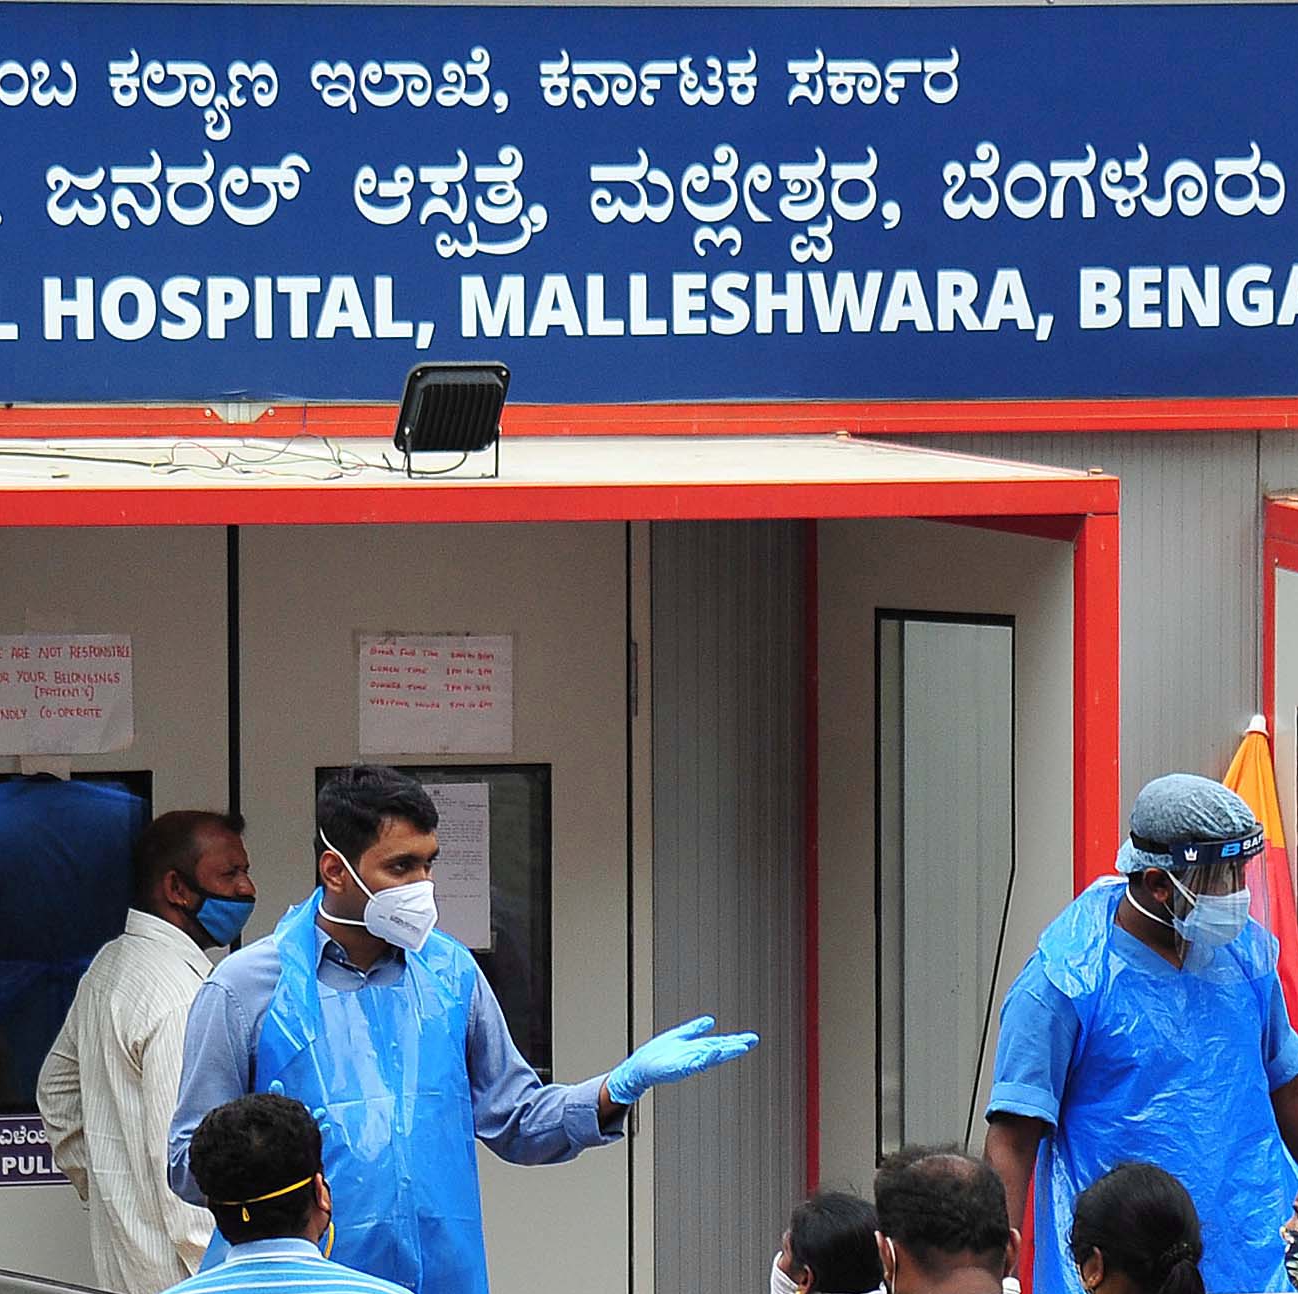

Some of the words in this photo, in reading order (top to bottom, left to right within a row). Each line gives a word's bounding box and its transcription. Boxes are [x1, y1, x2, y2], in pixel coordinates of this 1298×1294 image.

[109, 49, 279, 141] ಕಲ್ಯಾಣ
[310, 47, 509, 114] ಇಲಾಖೆ,
[539, 49, 758, 109] ಕರ್ನಾಟಕ
[787, 47, 959, 106] ಸರ್ಕಾರ
[46, 149, 311, 230] ಜನರಲ್
[590, 145, 901, 263] ಮಲ್ಲೇಶ್ವರ,
[942, 141, 1286, 220] ಬೆಂಗಳೂರು
[43, 276, 435, 349] HOSPITAL,
[461, 269, 1054, 341] MALLESHWARA,
[11, 646, 30, 659] ARE
[38, 645, 63, 659] NOT
[69, 645, 131, 660] RESPONSIBLE
[17, 670, 48, 683] YOUR
[54, 671, 121, 685] BELONGINGS
